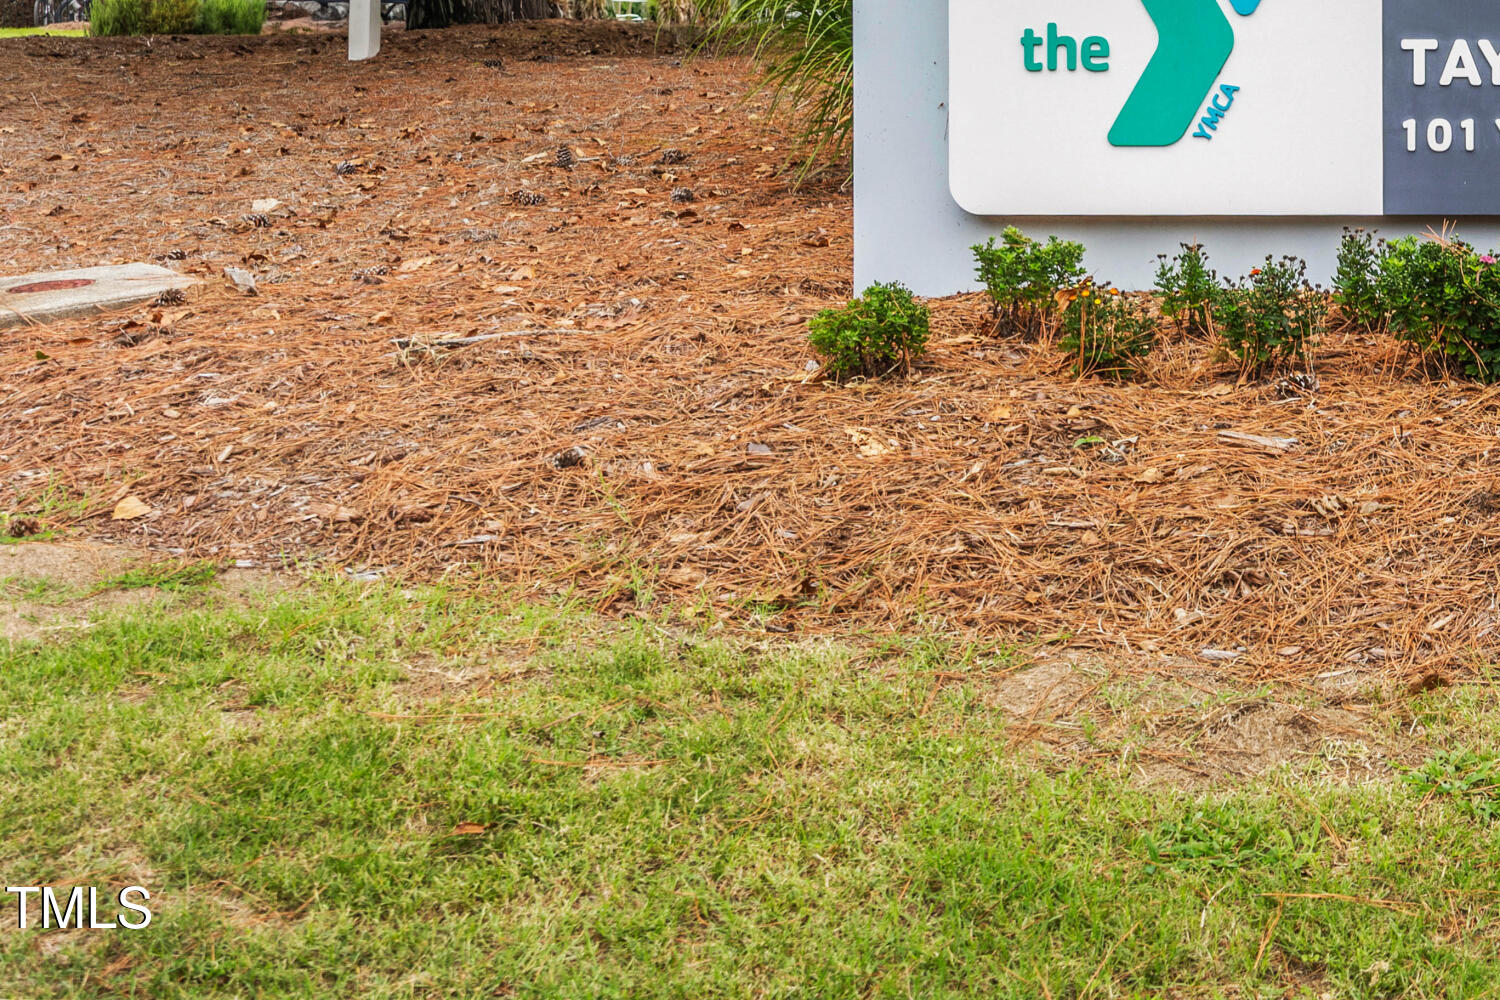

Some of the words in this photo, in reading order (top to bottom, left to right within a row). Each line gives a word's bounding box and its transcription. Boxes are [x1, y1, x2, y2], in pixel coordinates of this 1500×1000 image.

[1020, 22, 1111, 72] the
[1192, 83, 1241, 141] YMCA
[1401, 118, 1476, 153] 101
